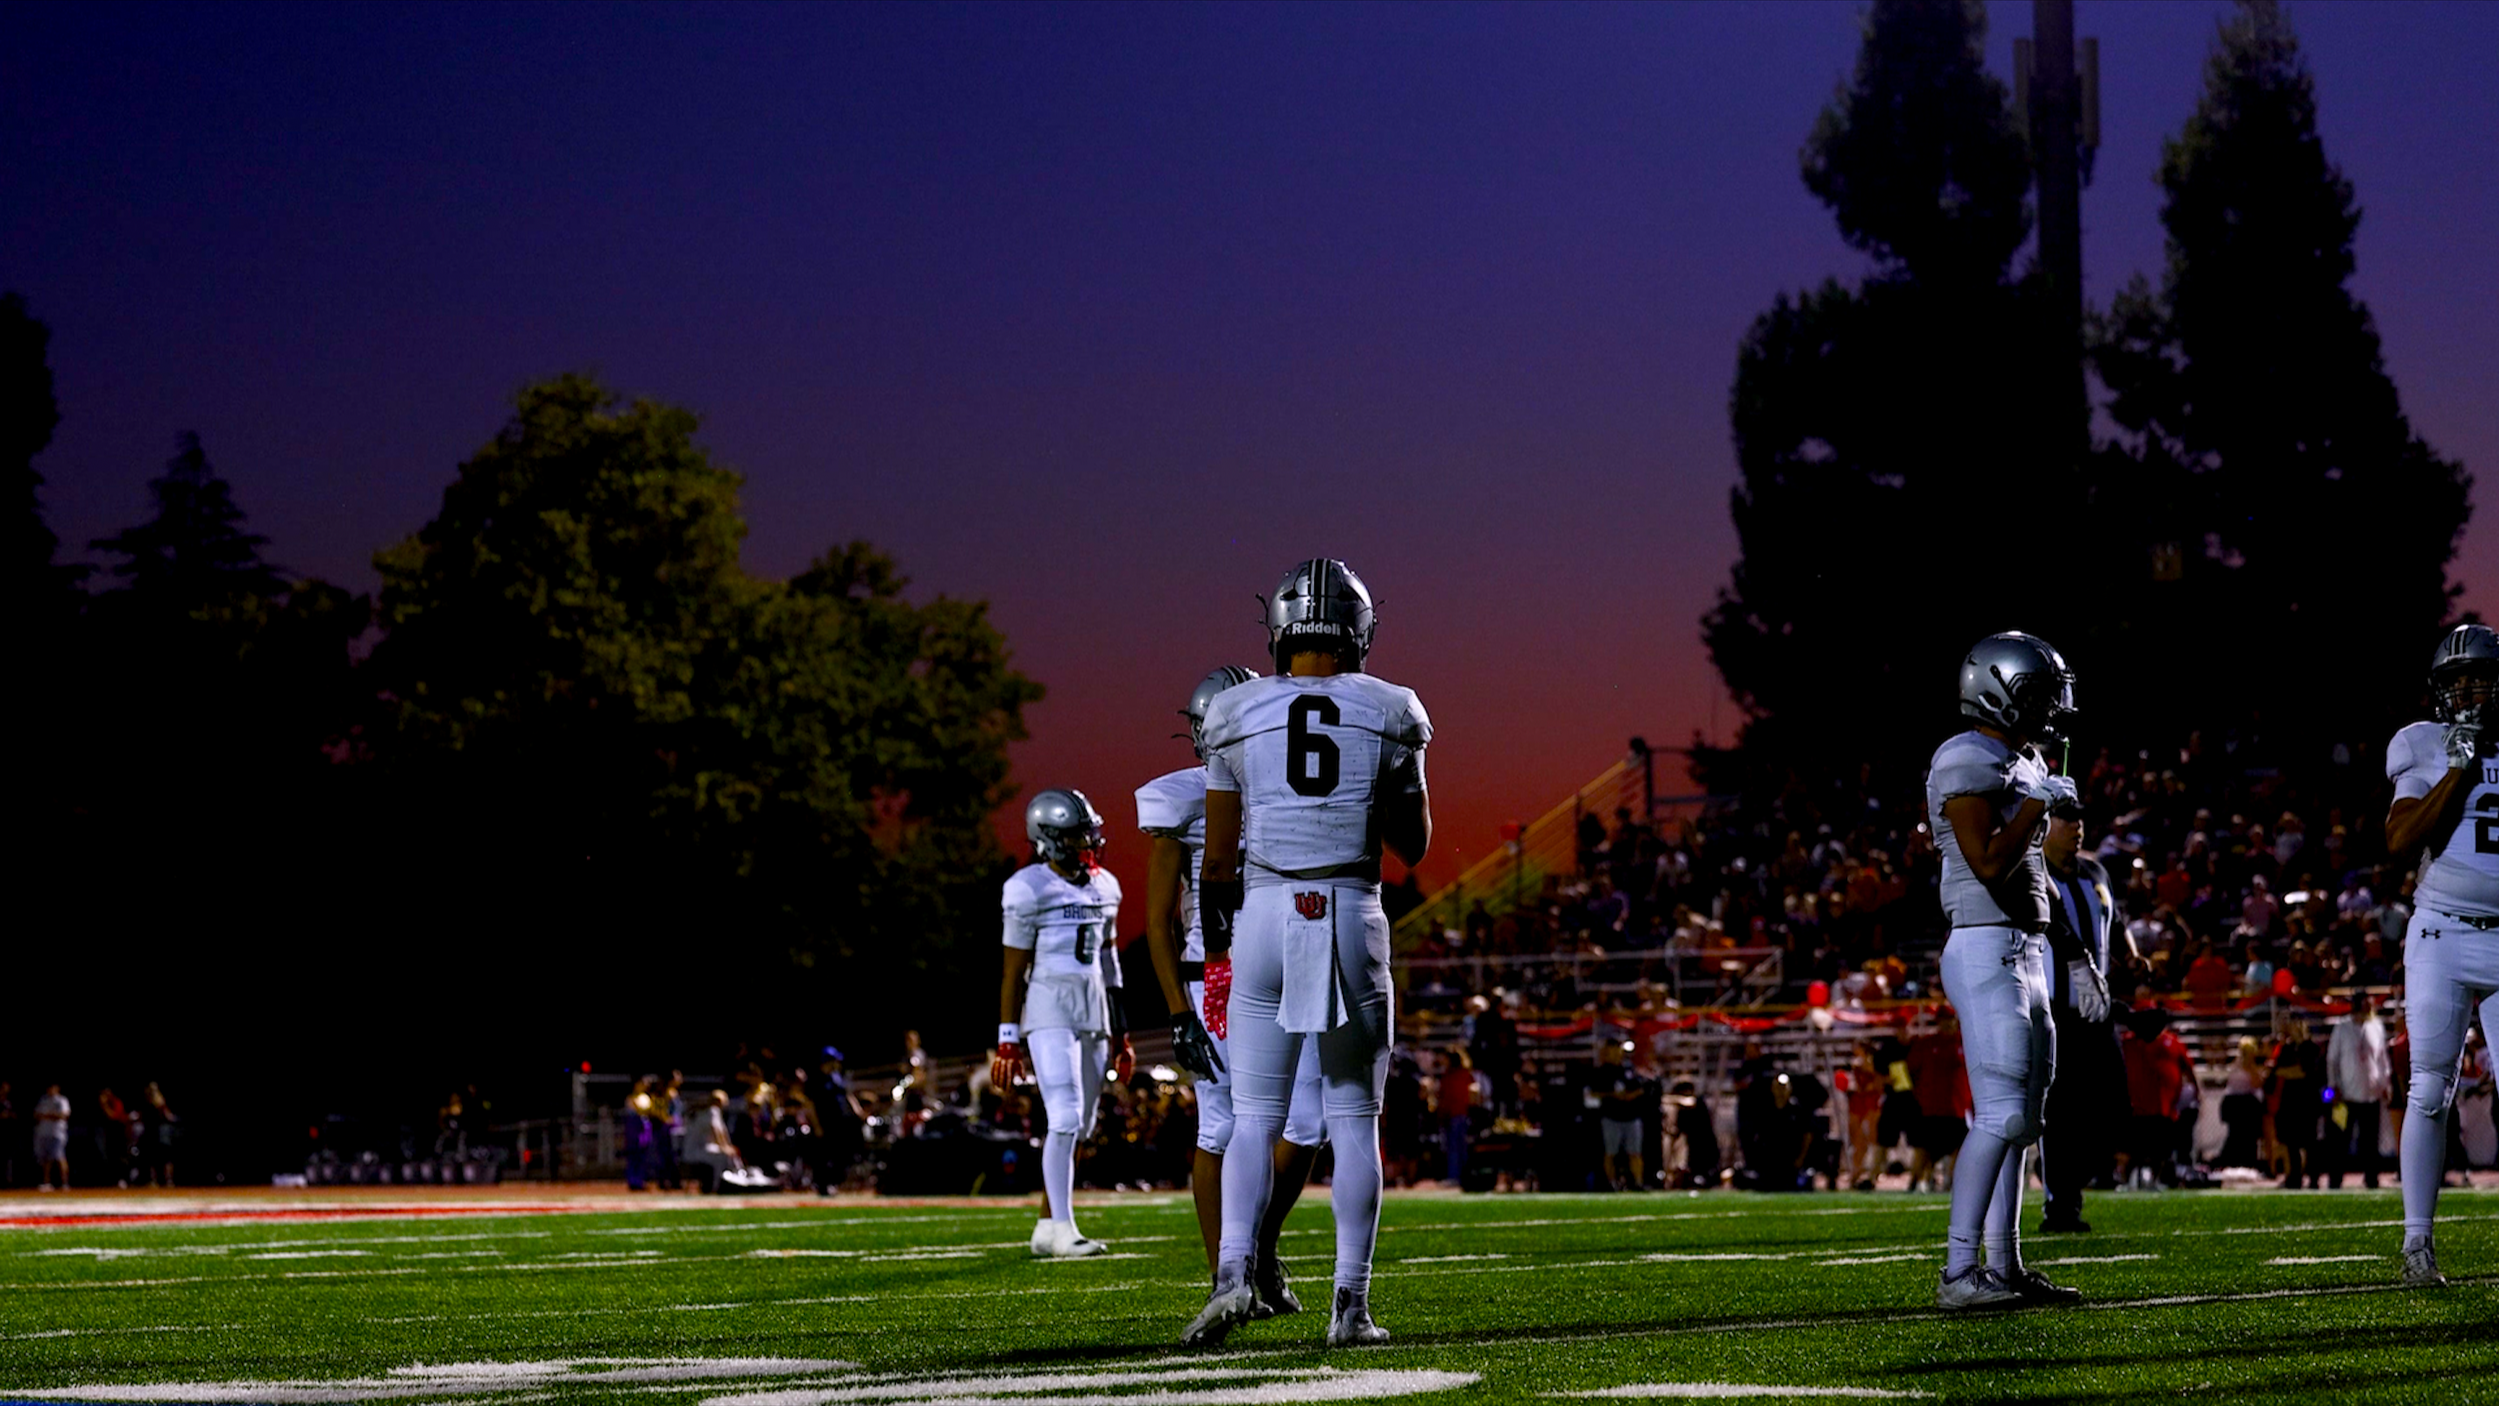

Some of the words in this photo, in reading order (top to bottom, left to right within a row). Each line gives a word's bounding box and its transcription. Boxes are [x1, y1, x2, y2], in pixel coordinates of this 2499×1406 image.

[1292, 621, 1341, 636] Riddell
[1287, 695, 1340, 796] 6
[1063, 904, 1103, 920] BRUINS
